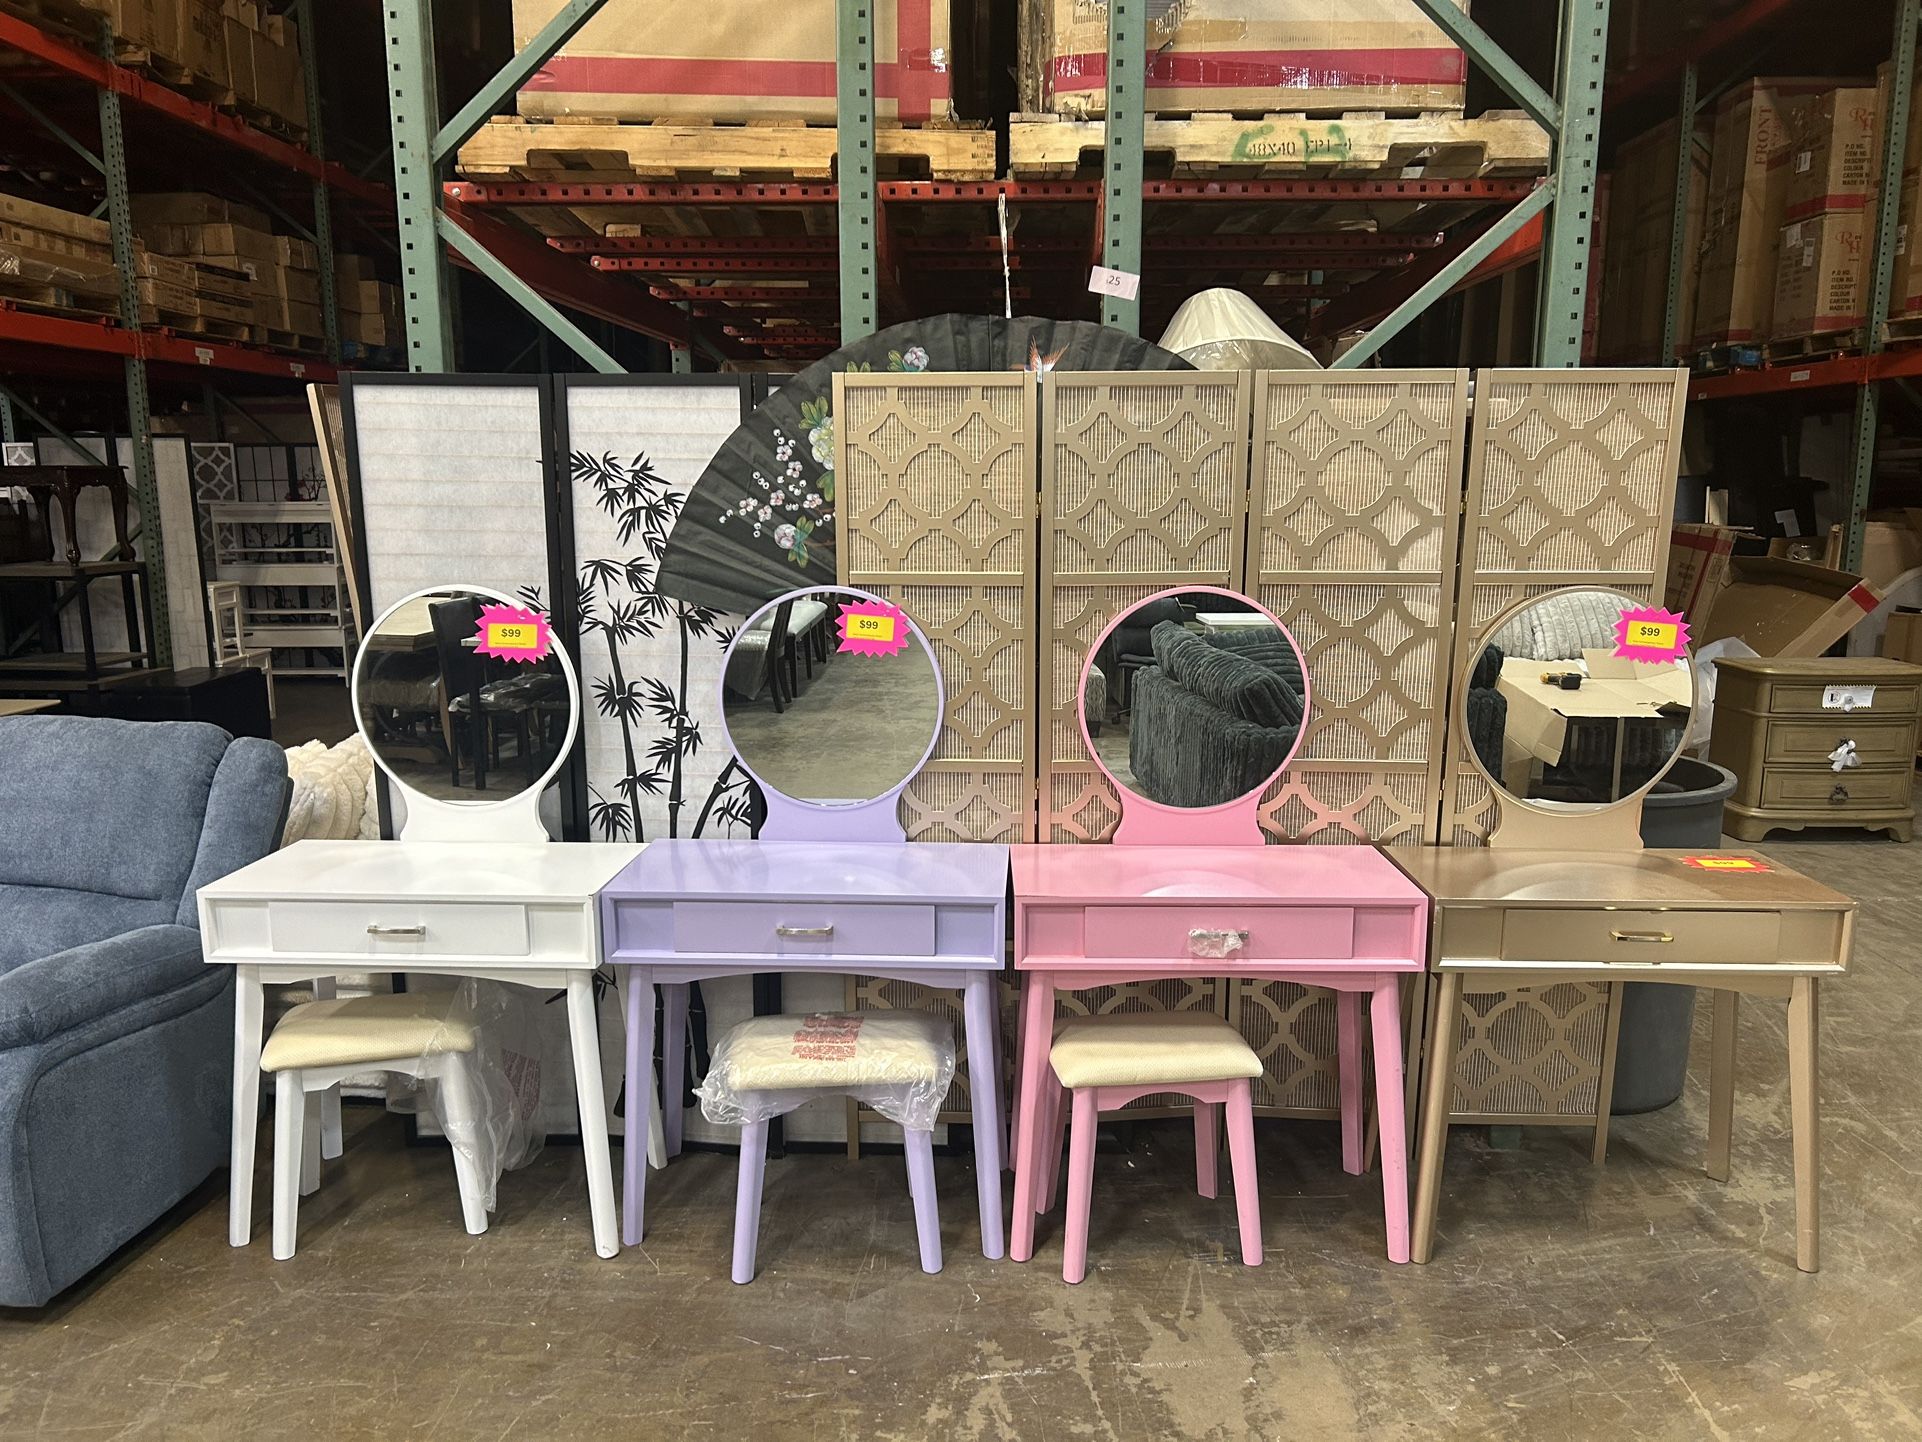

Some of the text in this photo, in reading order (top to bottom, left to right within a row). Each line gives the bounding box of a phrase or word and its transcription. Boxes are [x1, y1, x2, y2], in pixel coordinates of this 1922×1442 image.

[1755, 105, 1772, 164] FRONT
[859, 619, 879, 630] $99
[501, 628, 521, 638] $99
[1640, 626, 1660, 637] $99
